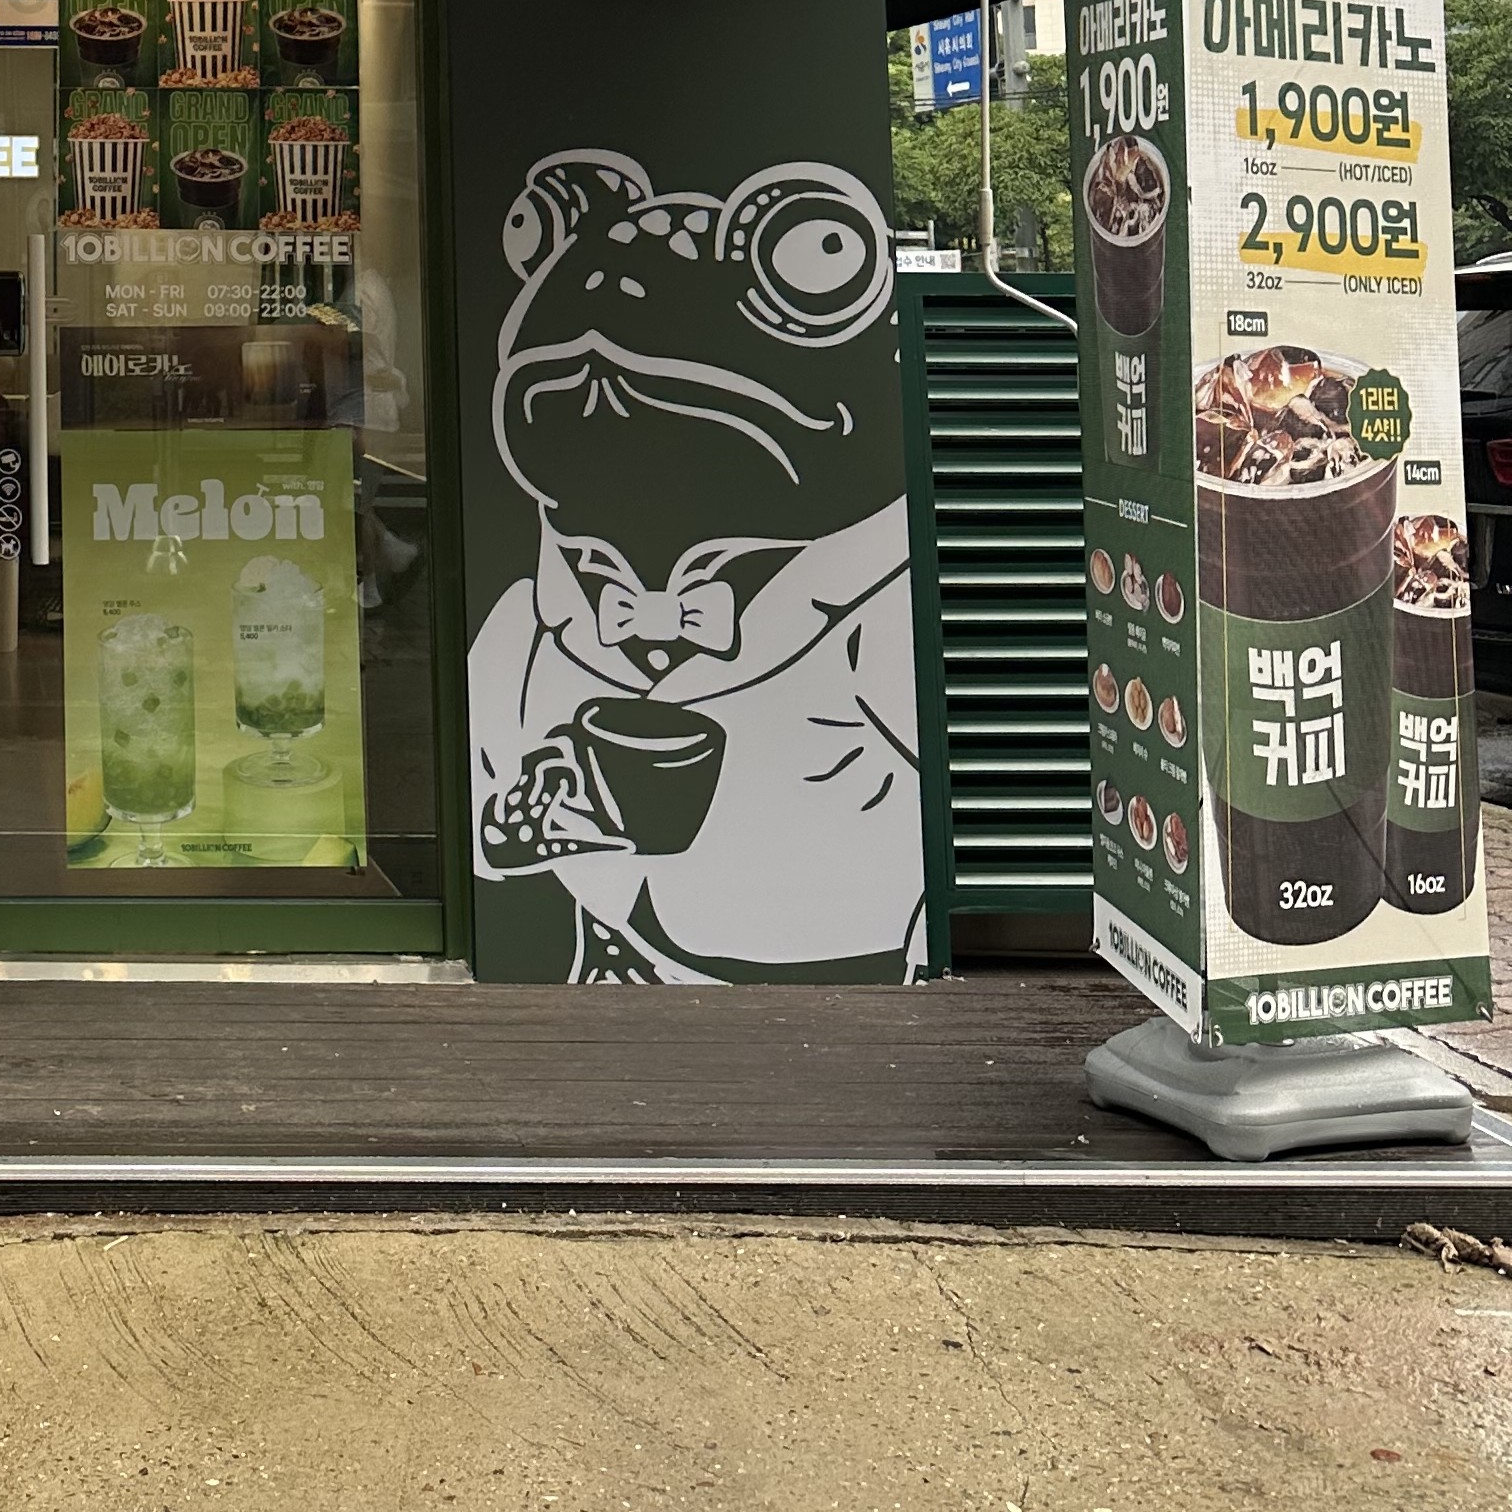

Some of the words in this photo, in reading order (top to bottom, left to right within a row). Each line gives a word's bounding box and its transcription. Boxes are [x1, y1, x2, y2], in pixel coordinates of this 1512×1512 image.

[193, 43, 222, 52] COFFEE
[169, 91, 249, 122] GRAND
[1079, 53, 1170, 152] 1,900원
[1241, 79, 1411, 151] 1,900원
[170, 123, 249, 159] OPEN
[1243, 157, 1277, 177] 16oz
[1338, 161, 1413, 186] (HOT/ICED)
[92, 184, 123, 193] COFFEE
[1239, 191, 1420, 266] 2,900원
[61, 234, 224, 263] 10BILLION
[229, 234, 352, 264] COFFEE
[105, 285, 146, 299] MON
[159, 285, 185, 299] FRI
[1246, 271, 1283, 290] 32oz
[1342, 273, 1384, 295] (ONLY
[1386, 276, 1423, 297] ICED)
[105, 303, 140, 318] SAT
[153, 303, 187, 318] SUN
[1228, 314, 1266, 333] 18cm
[81, 354, 193, 378] 에어로카노
[1115, 351, 1146, 405] 백억
[1359, 387, 1399, 411] 1리터
[1116, 403, 1147, 456] 커피
[1361, 418, 1401, 442] 4샷!!
[1406, 464, 1439, 481] 14cm
[92, 479, 325, 541] Melon
[1118, 498, 1149, 524] DESSERT
[1248, 640, 1343, 717] 백억
[1252, 712, 1346, 787] 커피
[1398, 711, 1458, 763] 백억
[1397, 760, 1457, 809] 커피
[223, 843, 252, 852] COFFEE
[1279, 881, 1335, 910] 32oz
[1407, 873, 1446, 894] 16oz
[1108, 920, 1153, 986] 10BILLION
[1152, 965, 1188, 1011] COFFEE
[1245, 984, 1366, 1024] 10BILLION
[1367, 975, 1453, 1011] COFFEE
